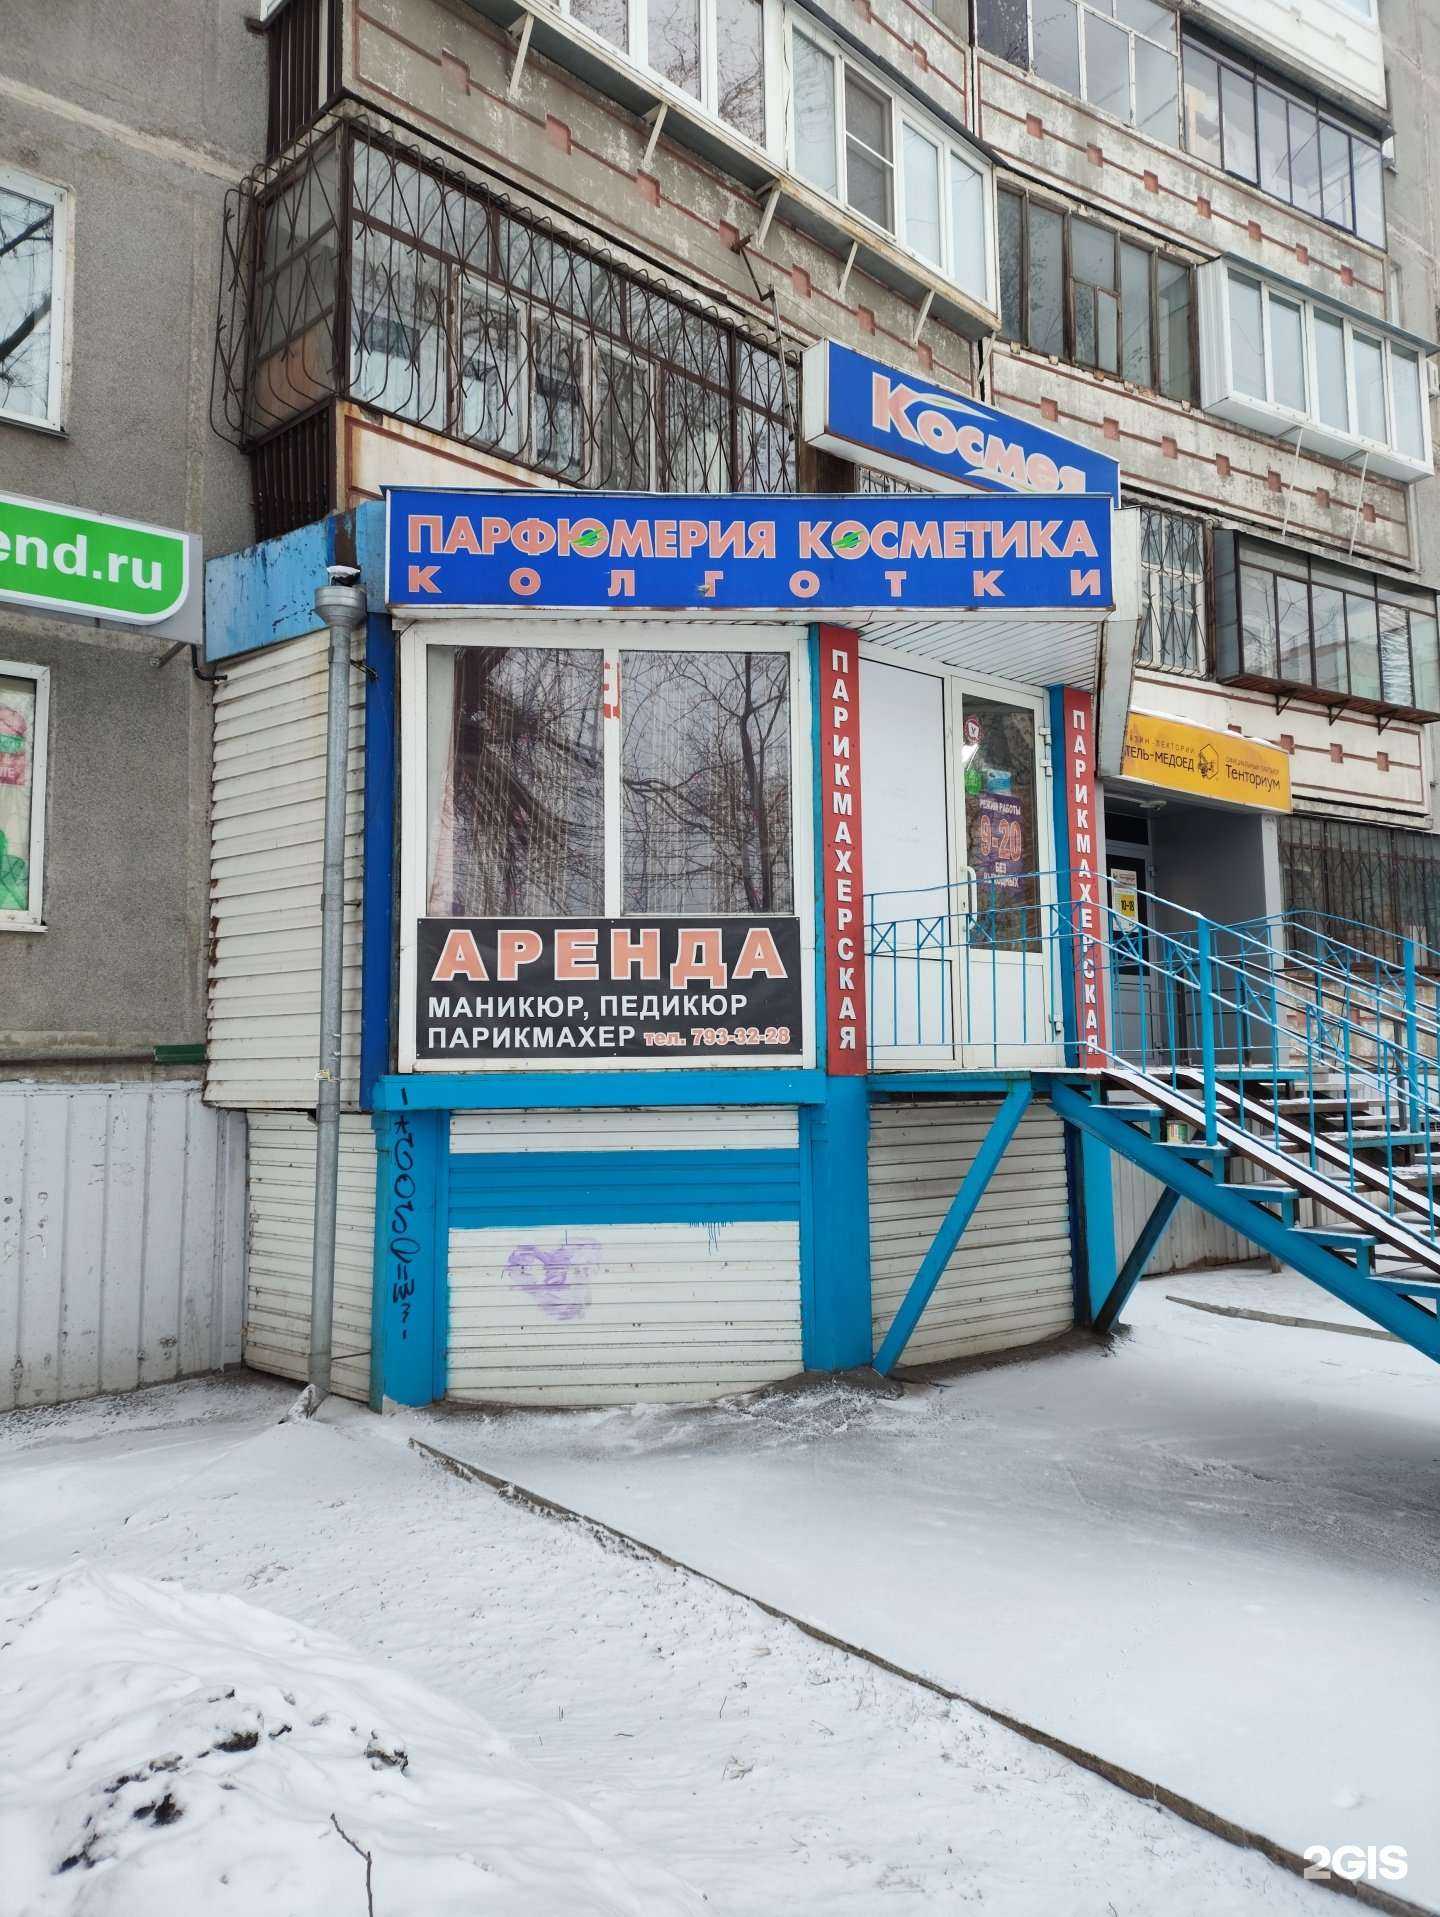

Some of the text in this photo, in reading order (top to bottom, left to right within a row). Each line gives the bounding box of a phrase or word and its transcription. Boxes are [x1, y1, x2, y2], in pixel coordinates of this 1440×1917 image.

[408, 514, 1099, 560] ПАРФЮМЕРИЯ КОСМЕТИКА
[1225, 764, 1280, 792] Тенториум
[831, 648, 857, 1050] ПАРИКМАХЕРСКАЯ
[981, 815, 1021, 861] 9-20
[1072, 709, 1100, 1055] ПАРИКМАХЕРСКАЯ
[431, 927, 788, 990] АРЕНДА
[428, 995, 747, 1021] МАНИКЮР, ПЕДИКЮР
[428, 1026, 790, 1049] ПАРИКМАХЕР тел. 793-32-28
